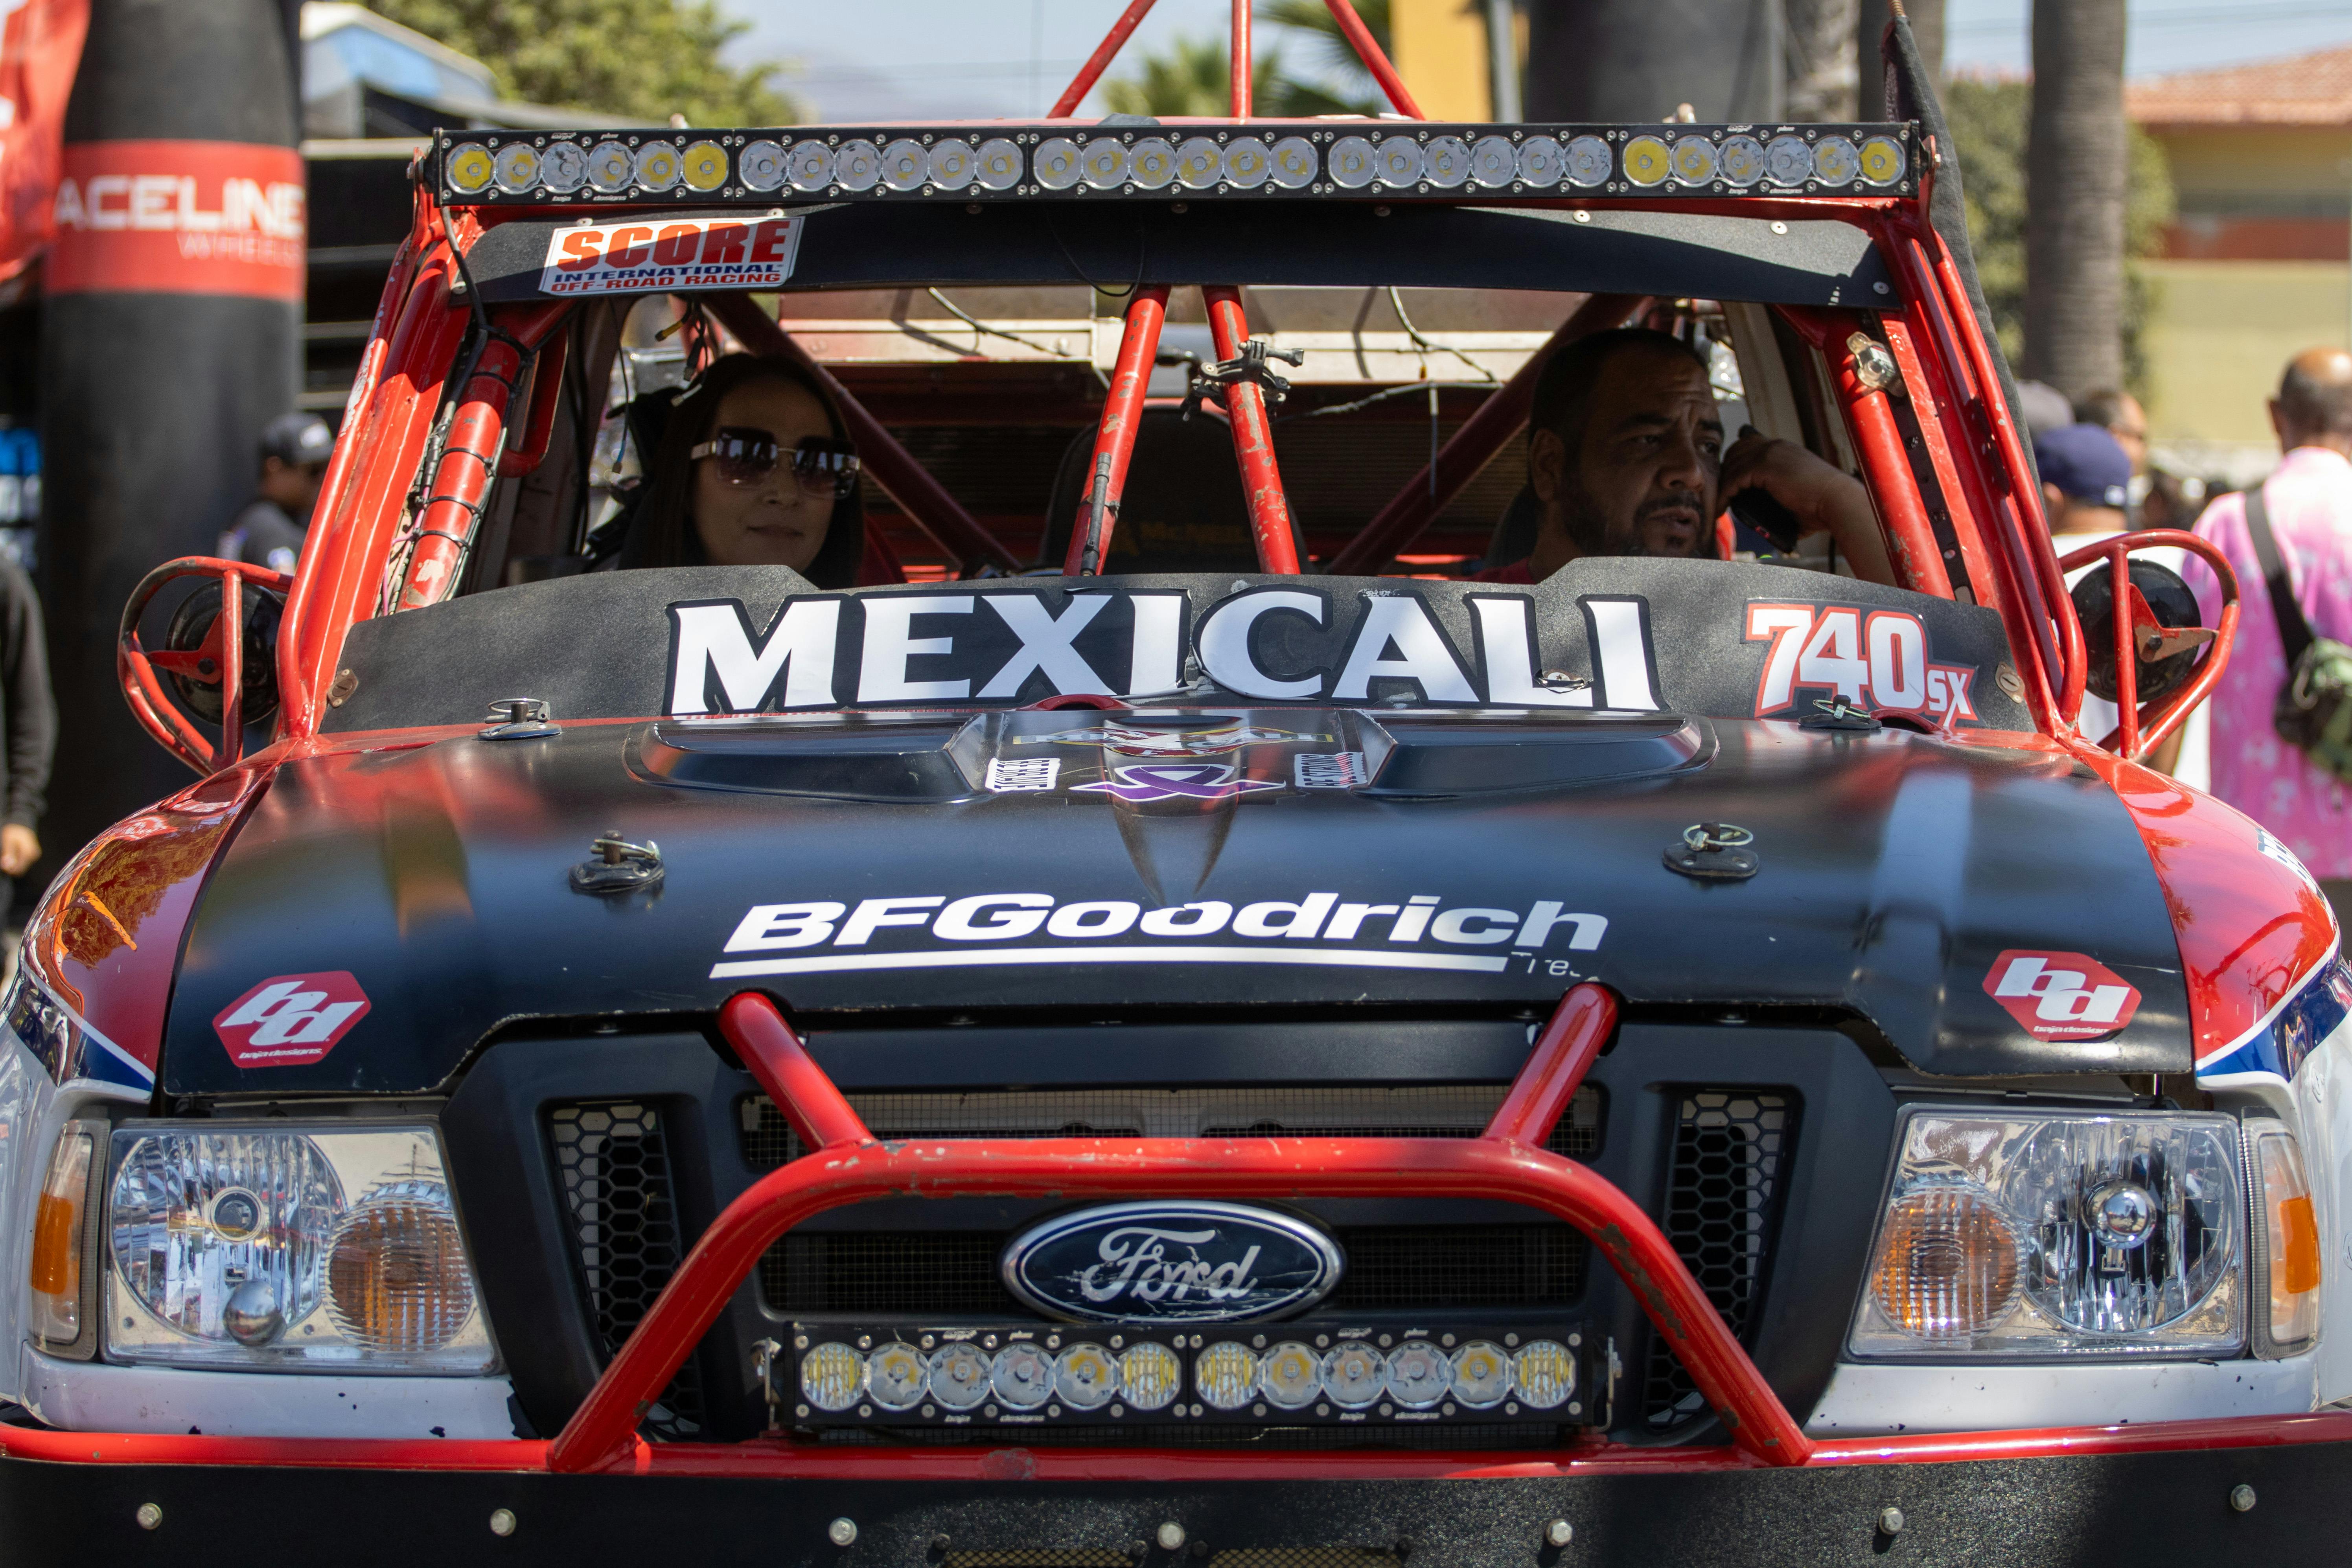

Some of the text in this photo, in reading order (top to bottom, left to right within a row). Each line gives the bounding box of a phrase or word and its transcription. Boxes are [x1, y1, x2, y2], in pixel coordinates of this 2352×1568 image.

[557, 221, 790, 272] SCORE
[551, 273, 781, 292] OFF-ROAD RACING
[668, 589, 1662, 716] MEXICALI
[1747, 605, 1927, 716] 740
[994, 768, 1049, 789] BRAVE
[1301, 753, 1355, 777] STRONG
[723, 892, 1609, 953] BFGoodrich
[1080, 1226, 1261, 1303] Ford
